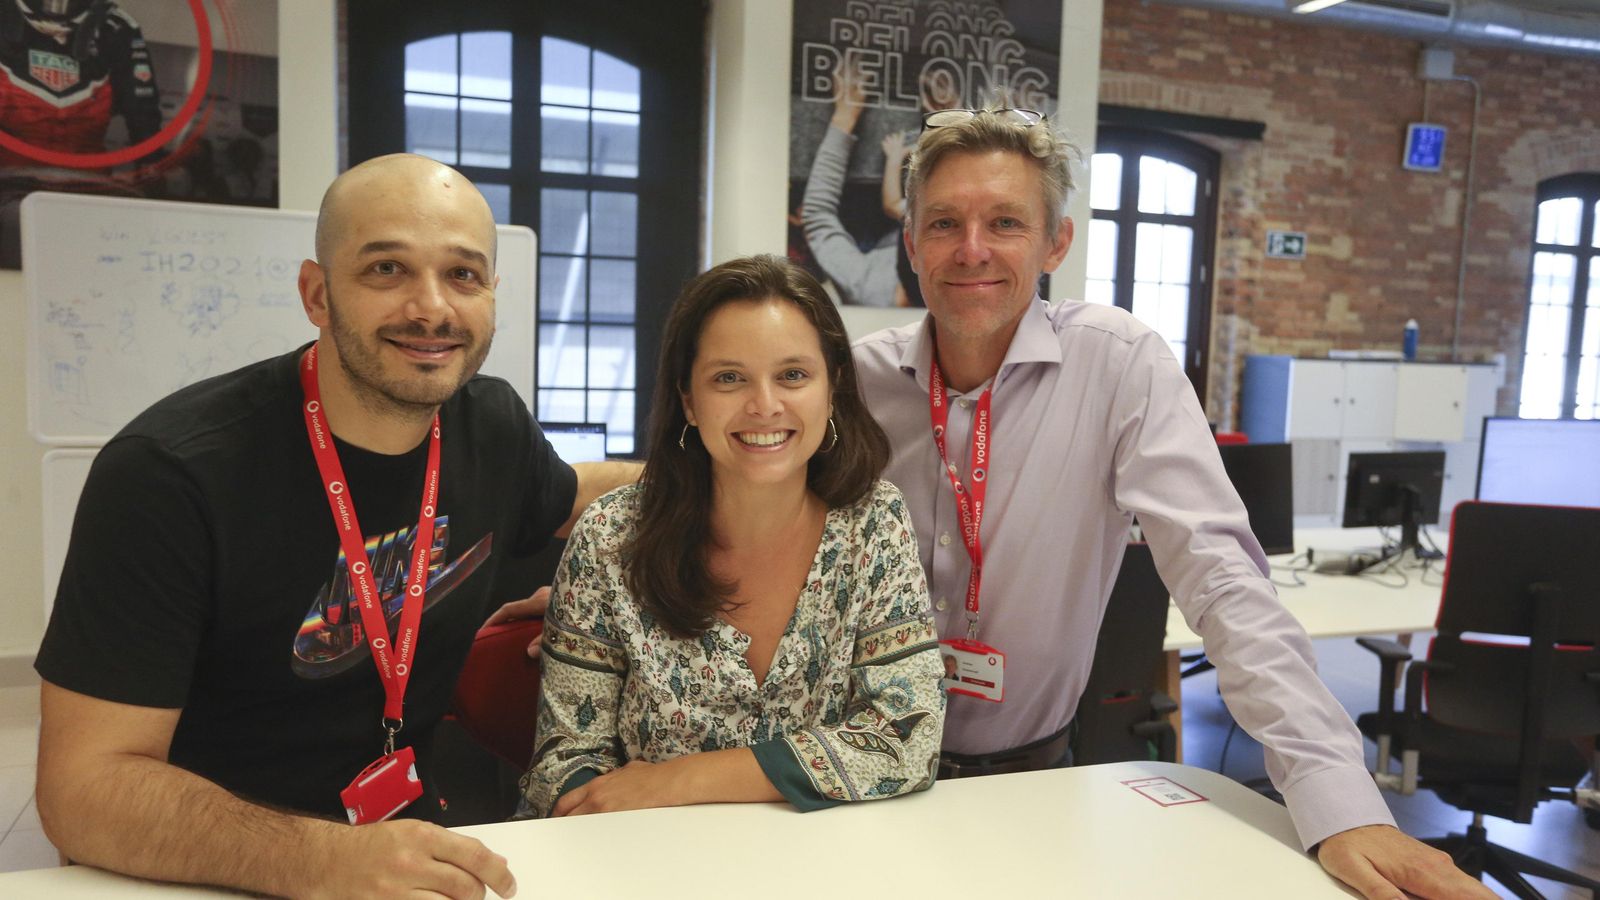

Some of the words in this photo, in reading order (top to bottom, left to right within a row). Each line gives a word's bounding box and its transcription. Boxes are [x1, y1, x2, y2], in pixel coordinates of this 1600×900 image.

[802, 42, 1050, 114] BELONG
[312, 414, 326, 449] vodafone
[976, 410, 987, 465] vodafone
[428, 469, 437, 504] vodafone
[336, 495, 351, 531] vodafone
[960, 496, 976, 548] vodafone
[415, 548, 426, 584] vodafone
[359, 574, 372, 609] vodafone
[401, 628, 413, 663] vodafone
[380, 649, 391, 679] vodafone
